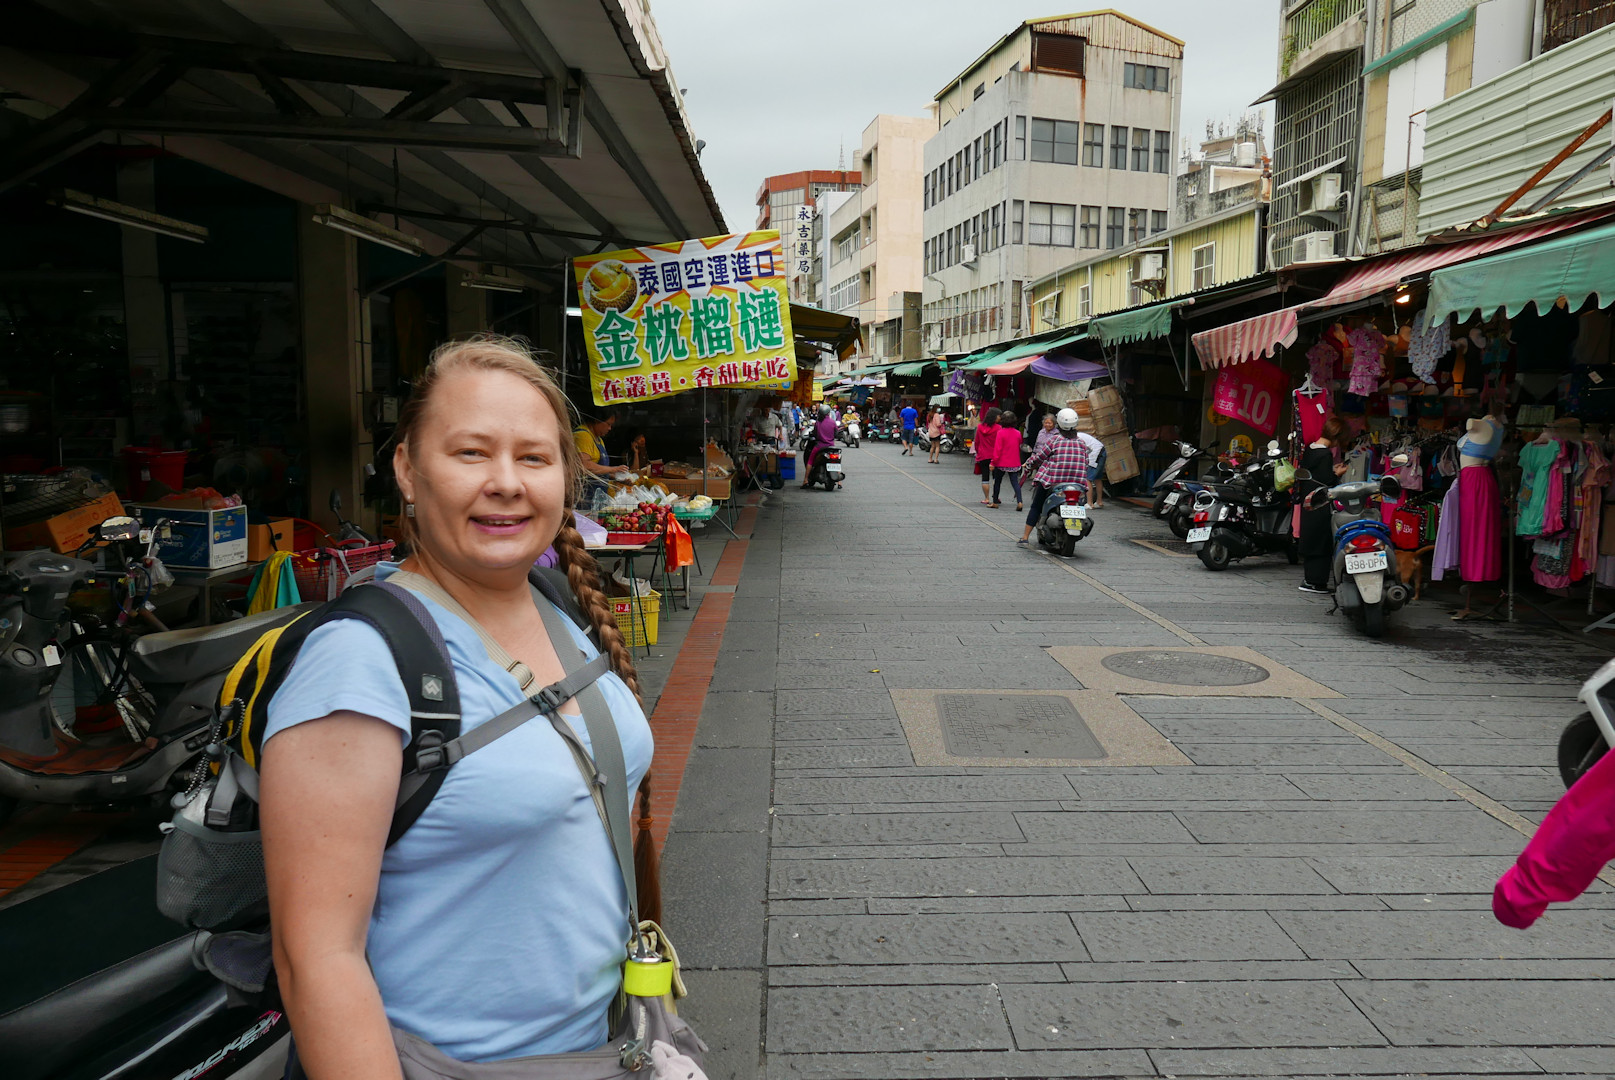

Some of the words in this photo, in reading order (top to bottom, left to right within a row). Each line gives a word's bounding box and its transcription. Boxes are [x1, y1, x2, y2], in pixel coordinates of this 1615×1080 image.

[637, 250, 775, 296] 泰國空運進口
[593, 287, 785, 371] 金枕榴槤
[1237, 383, 1271, 425] 10
